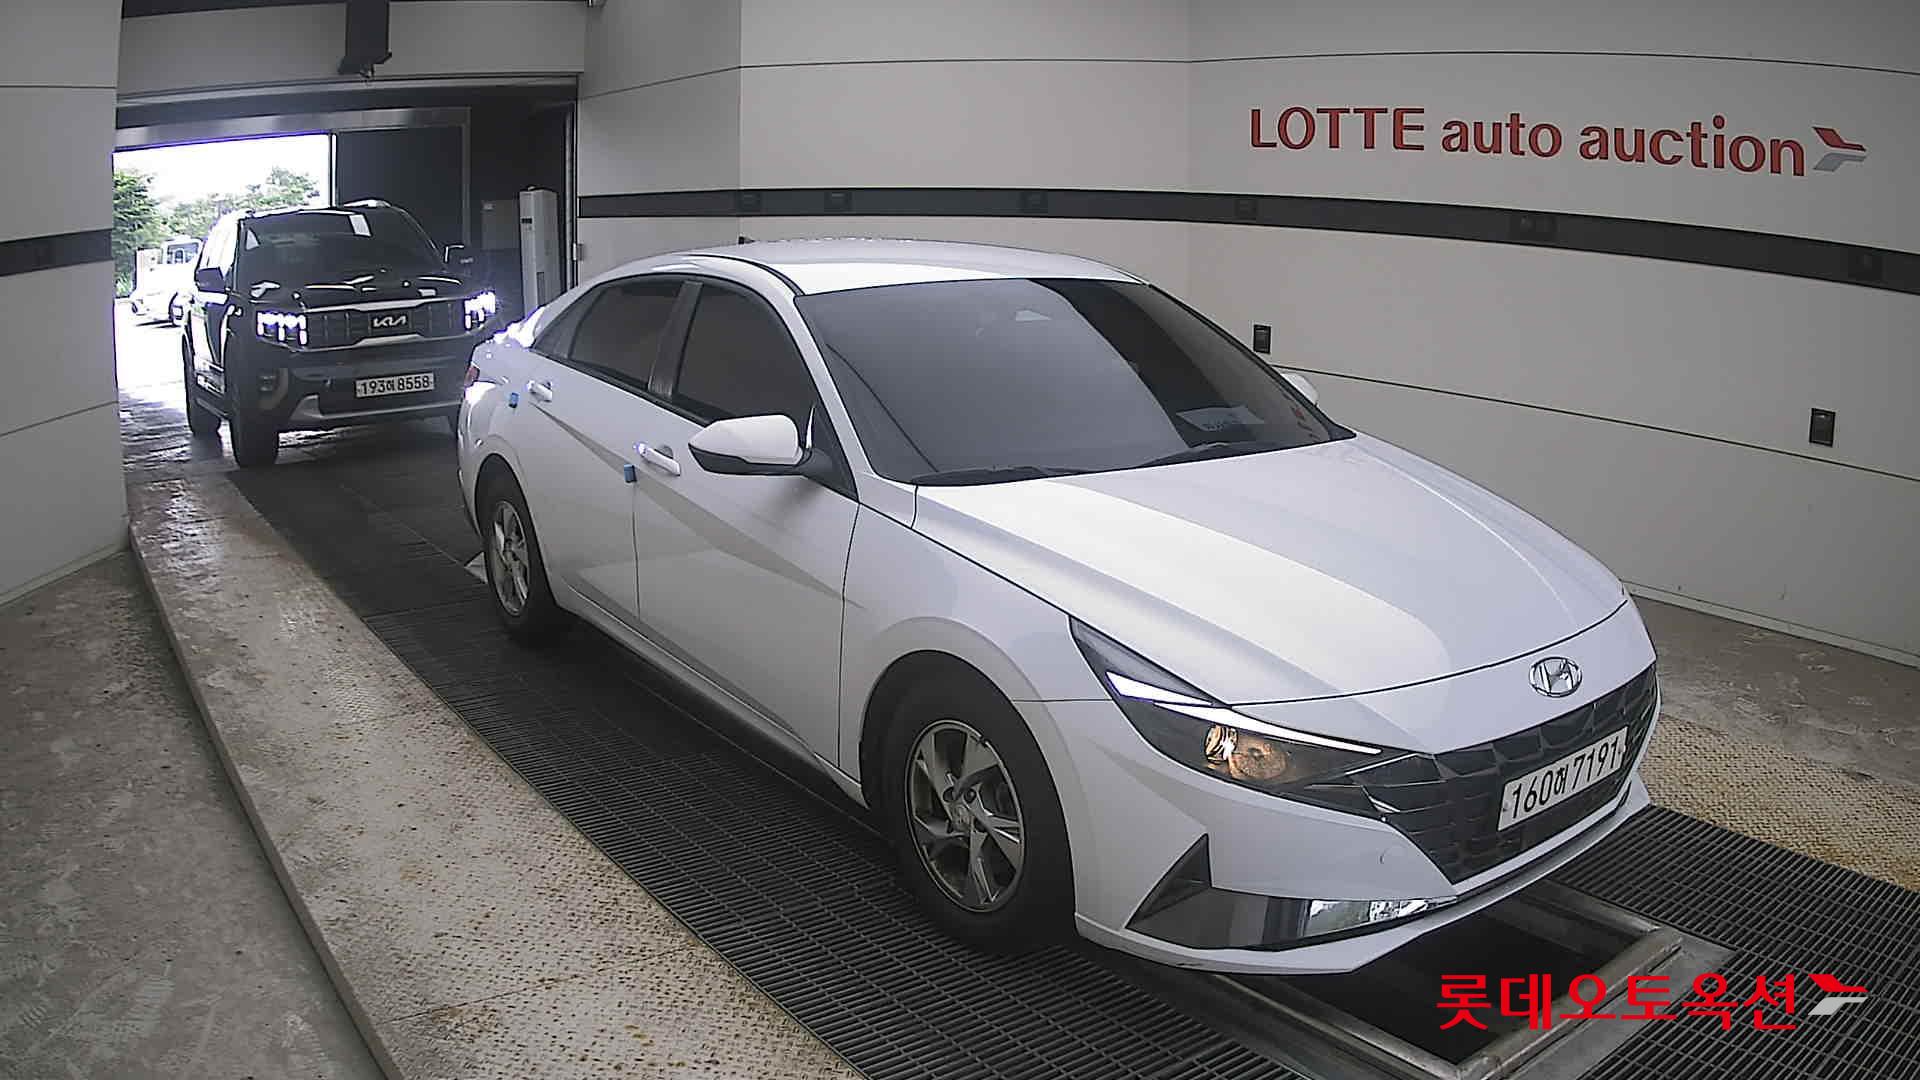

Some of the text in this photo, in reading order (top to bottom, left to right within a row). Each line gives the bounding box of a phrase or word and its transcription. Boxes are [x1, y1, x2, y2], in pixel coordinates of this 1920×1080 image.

[1250, 107, 1806, 177] LOTTE auto auction
